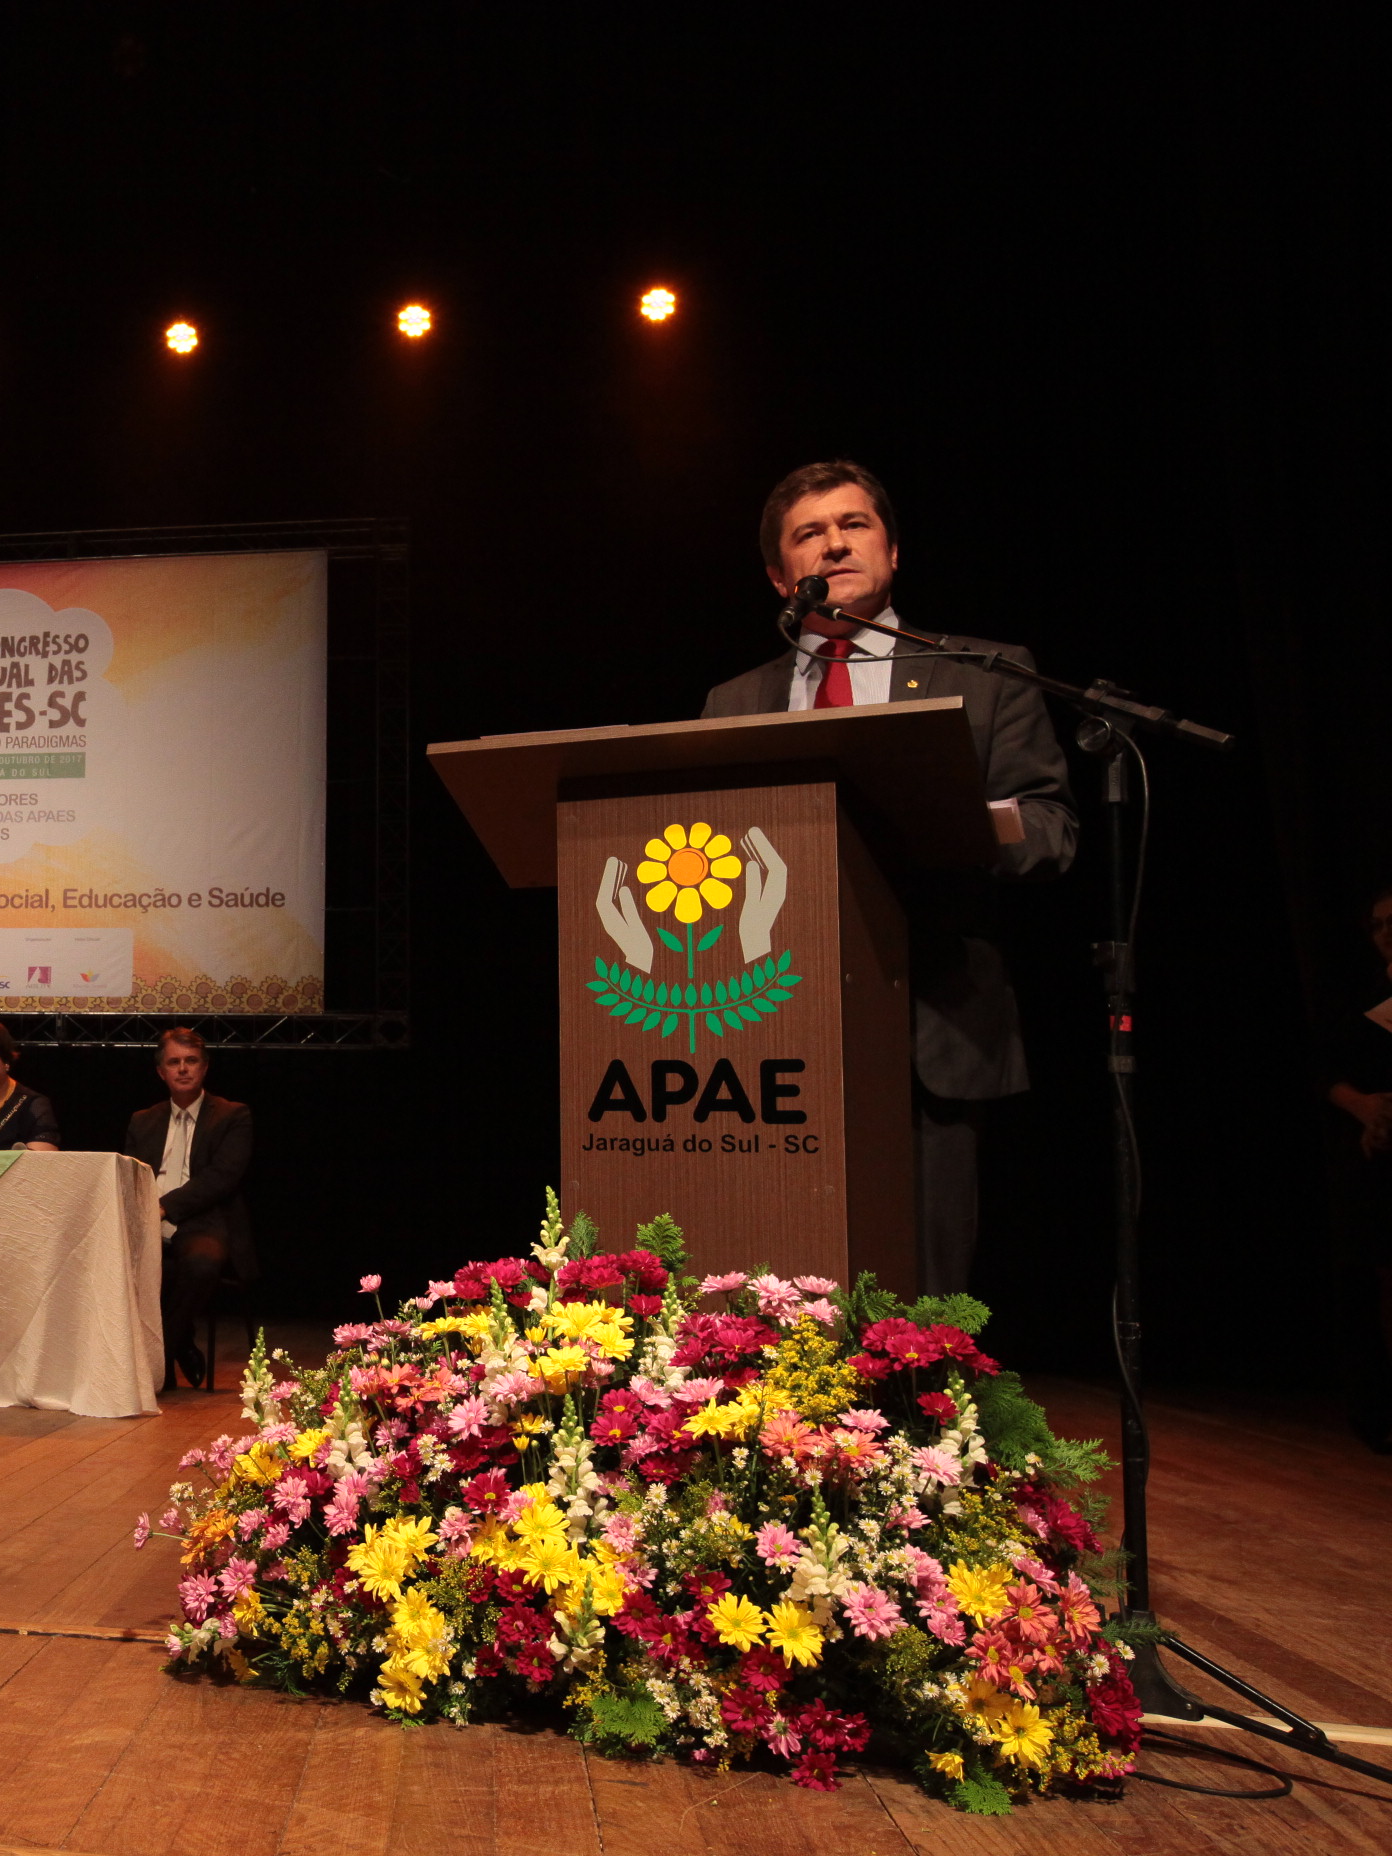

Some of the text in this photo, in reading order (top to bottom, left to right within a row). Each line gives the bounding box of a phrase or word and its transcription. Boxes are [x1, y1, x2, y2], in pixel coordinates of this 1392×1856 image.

[47, 659, 88, 684] DAS
[6, 734, 86, 749] PARADIGMAS
[0, 755, 40, 764] OUTUBRO
[44, 755, 56, 764] DE
[60, 755, 82, 763] 2017
[32, 768, 51, 776] SUL
[27, 810, 76, 822] APAES
[62, 888, 183, 915] Educação
[186, 893, 203, 910] e
[208, 887, 286, 911] Saúde
[588, 1058, 807, 1124] APAE
[582, 1133, 674, 1156] Jaraguá
[682, 1134, 712, 1153] do
[721, 1134, 759, 1153] Sul
[784, 1134, 819, 1154] SC
